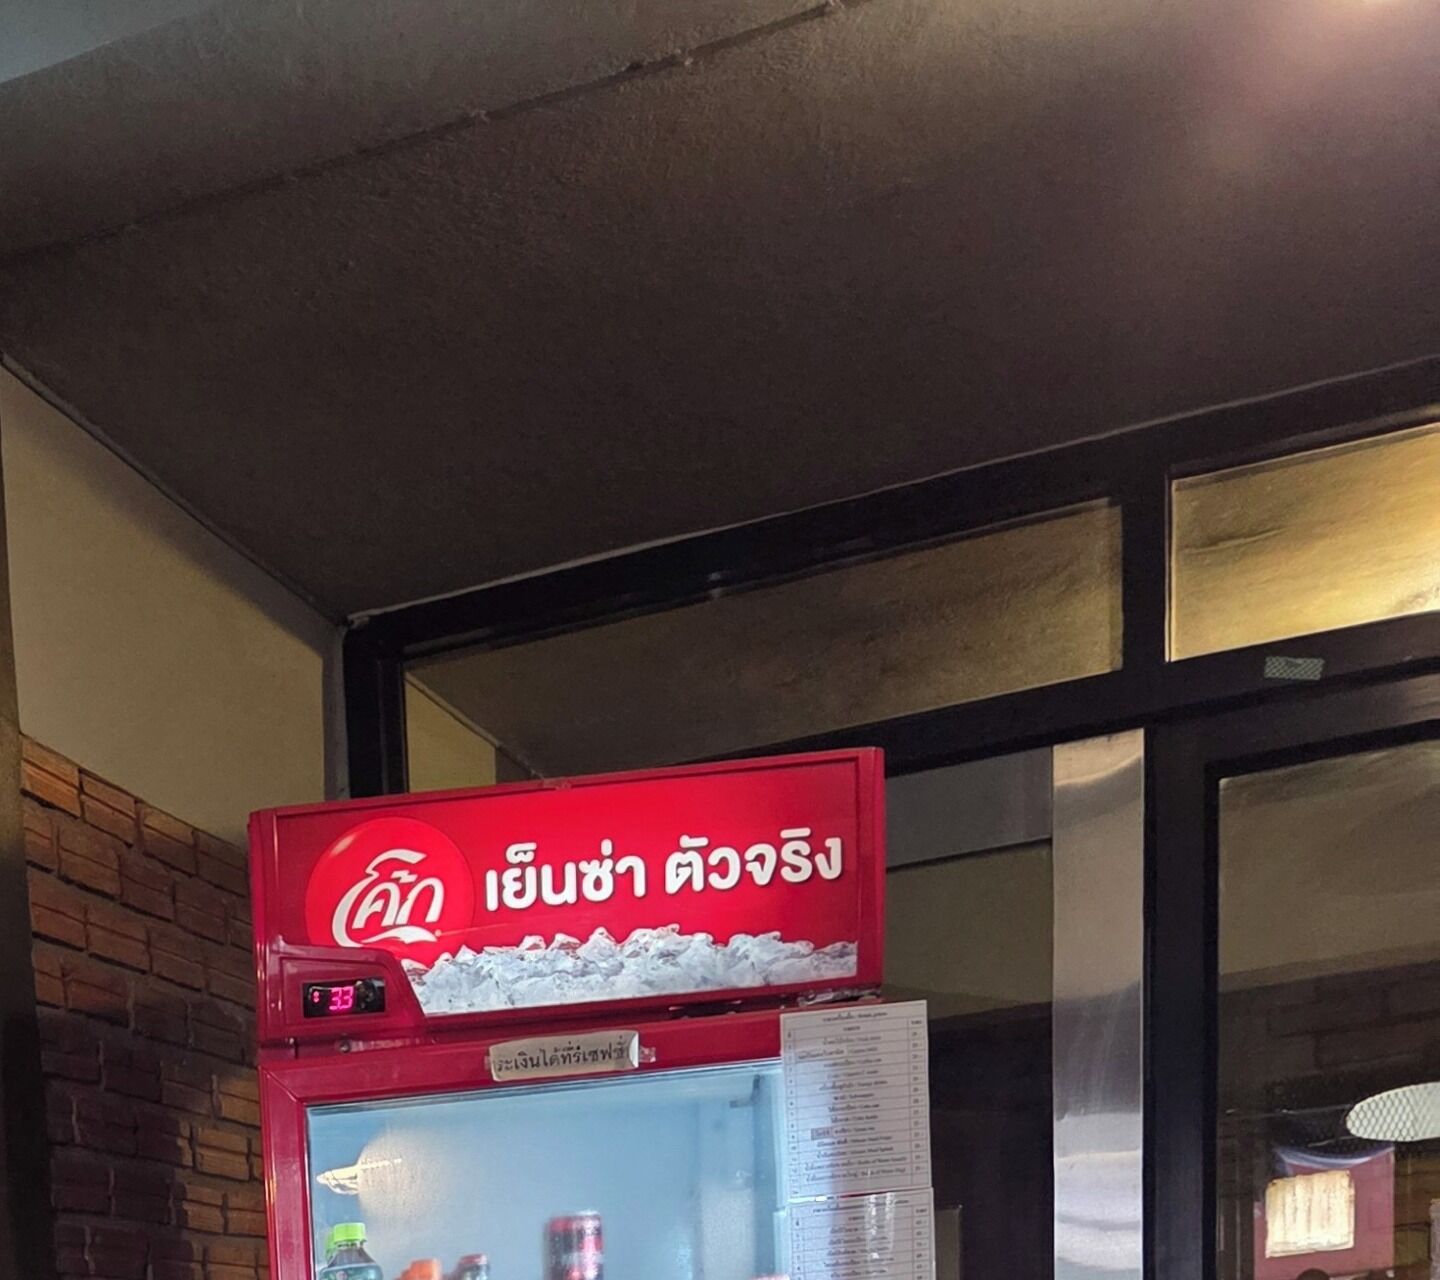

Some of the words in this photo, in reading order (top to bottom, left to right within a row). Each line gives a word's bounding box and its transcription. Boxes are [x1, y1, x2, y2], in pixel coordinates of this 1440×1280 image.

[485, 840, 646, 912] เย็นซ่า
[663, 827, 843, 895] ตัวจริง
